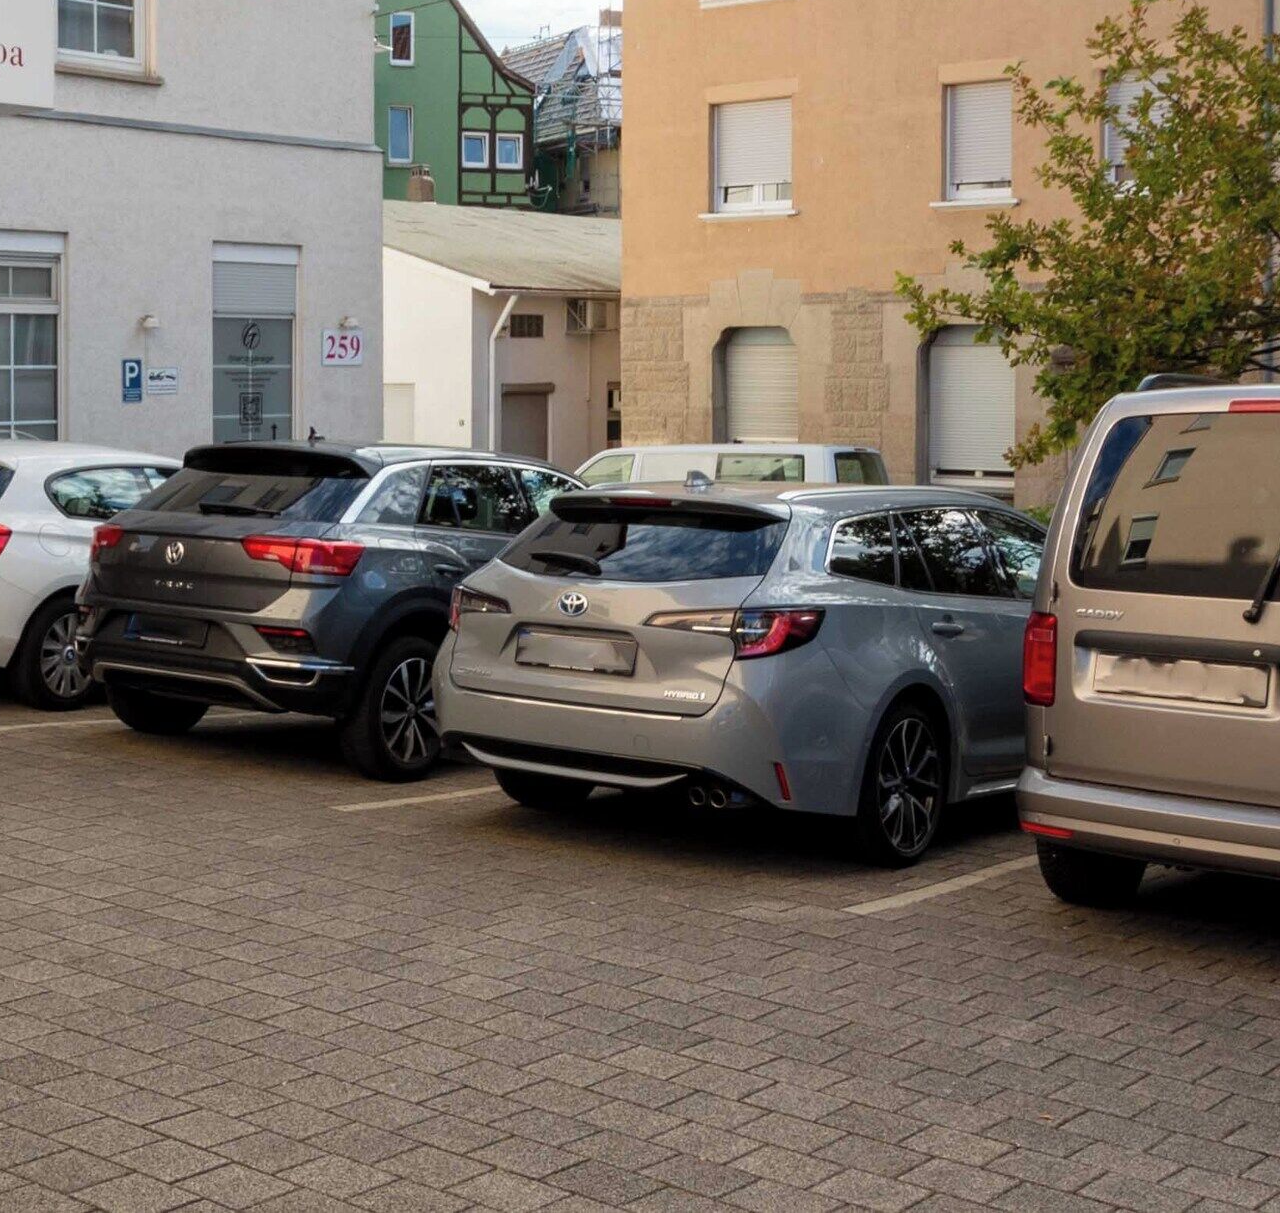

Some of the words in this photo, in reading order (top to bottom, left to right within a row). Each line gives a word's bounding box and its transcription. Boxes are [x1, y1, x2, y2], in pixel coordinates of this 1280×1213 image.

[325, 335, 361, 360] 259
[125, 362, 139, 387] P
[1076, 608, 1125, 621] CADDY
